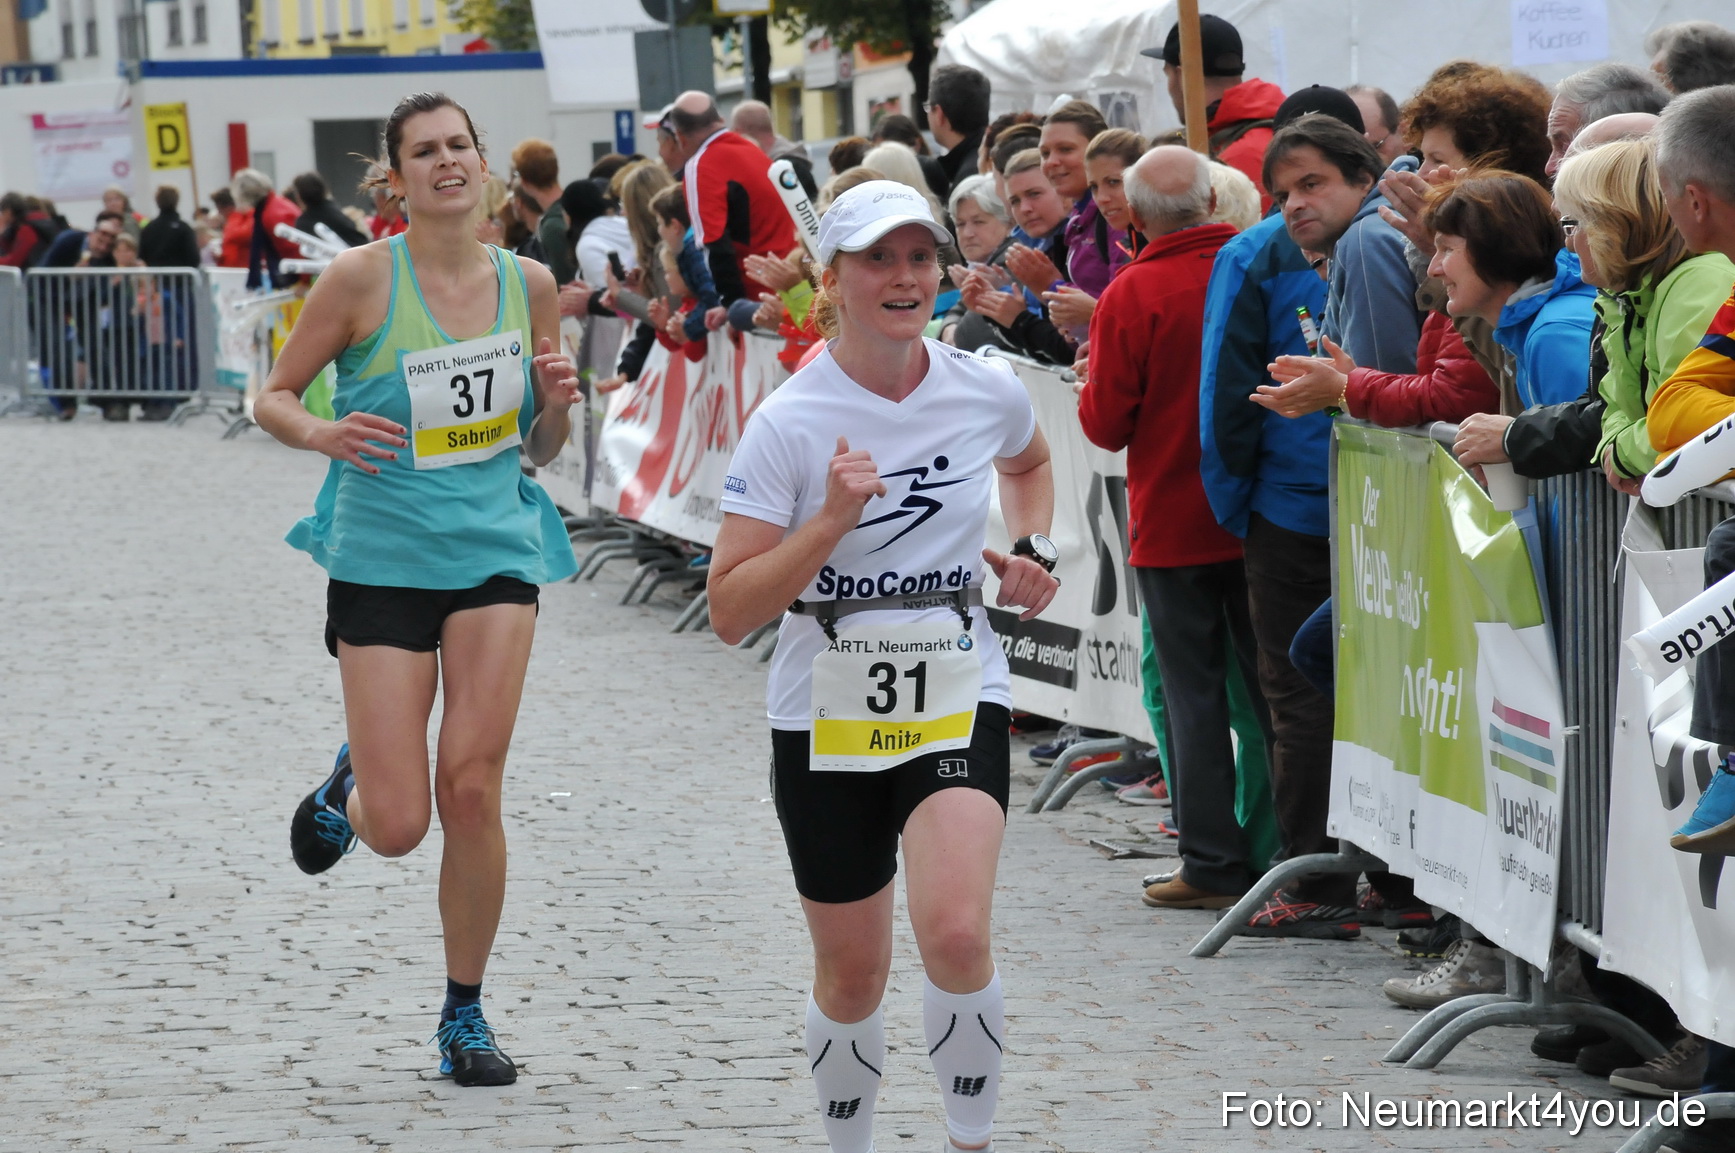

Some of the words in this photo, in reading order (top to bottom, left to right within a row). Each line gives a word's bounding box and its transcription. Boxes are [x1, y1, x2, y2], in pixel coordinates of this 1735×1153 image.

[157, 123, 181, 155] D
[886, 192, 914, 201] asics
[408, 360, 451, 377] PARTL
[452, 347, 507, 368] Neumarkt
[449, 367, 495, 419] 37
[447, 424, 502, 449] Sabrina
[1362, 476, 1380, 527] Der
[1351, 523, 1393, 619] Neue
[878, 638, 952, 653] Neumarkt
[1660, 597, 1735, 664] rt.de
[1013, 636, 1037, 661] die
[1037, 644, 1077, 671] verbind
[866, 660, 927, 715] 31
[869, 729, 922, 751] Anita
